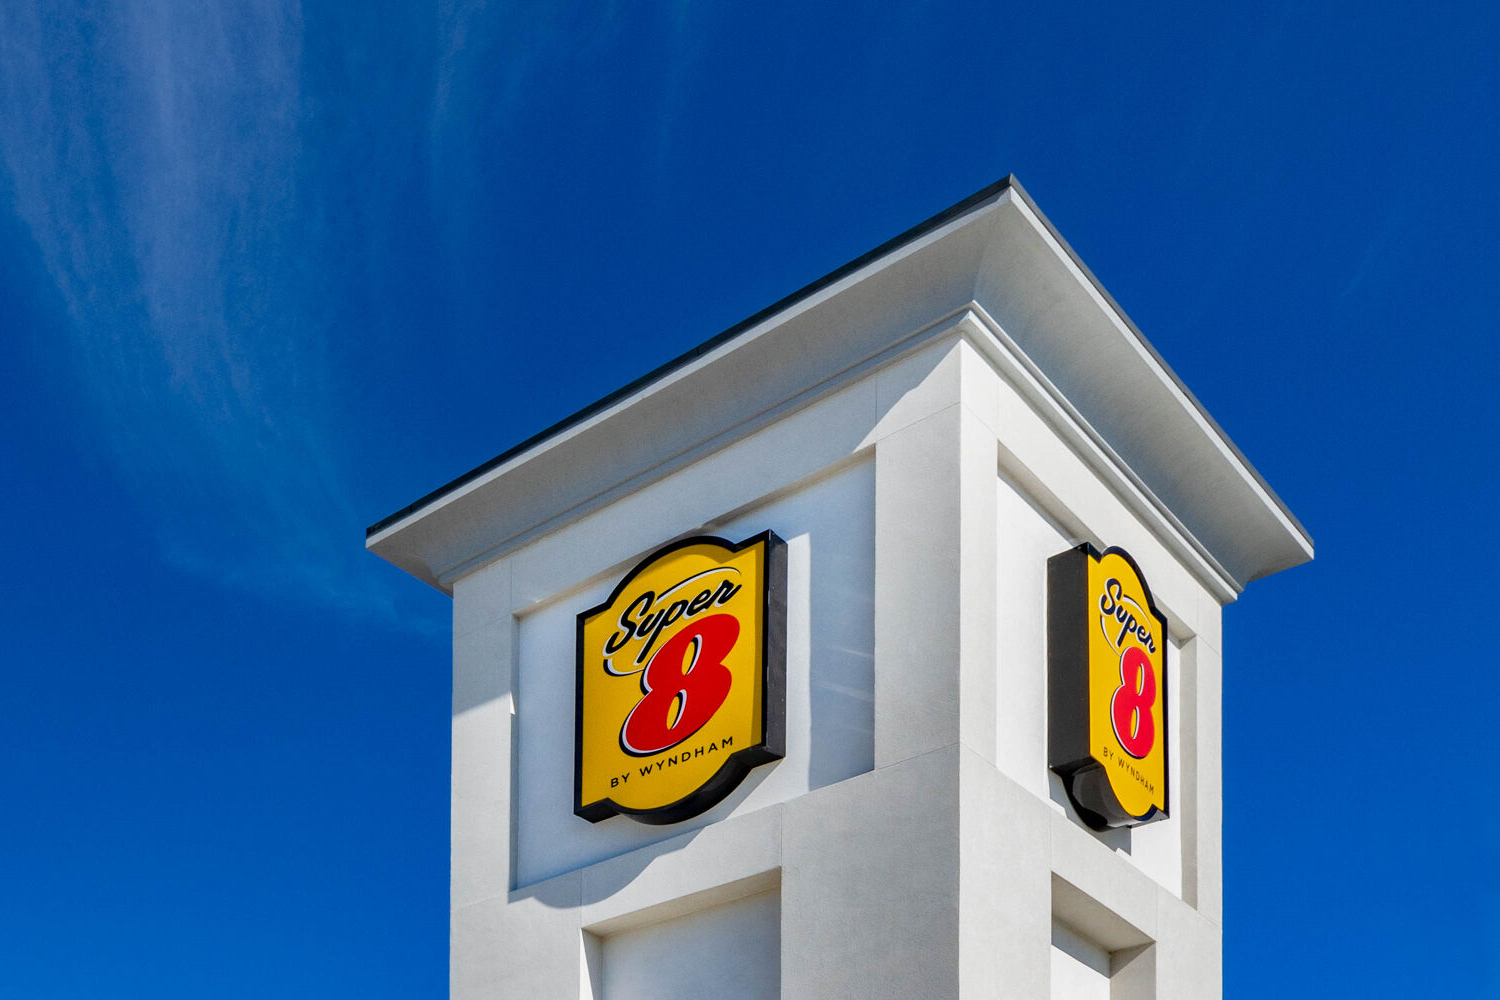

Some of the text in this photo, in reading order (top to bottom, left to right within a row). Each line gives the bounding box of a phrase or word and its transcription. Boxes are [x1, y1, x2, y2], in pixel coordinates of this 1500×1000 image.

[602, 578, 742, 666] Super
[1098, 577, 1156, 655] Super
[618, 613, 741, 758] 8
[1110, 646, 1156, 759] 8
[610, 736, 734, 788] BY WYNDHAM
[1103, 746, 1155, 795] BY WYNDHAM
